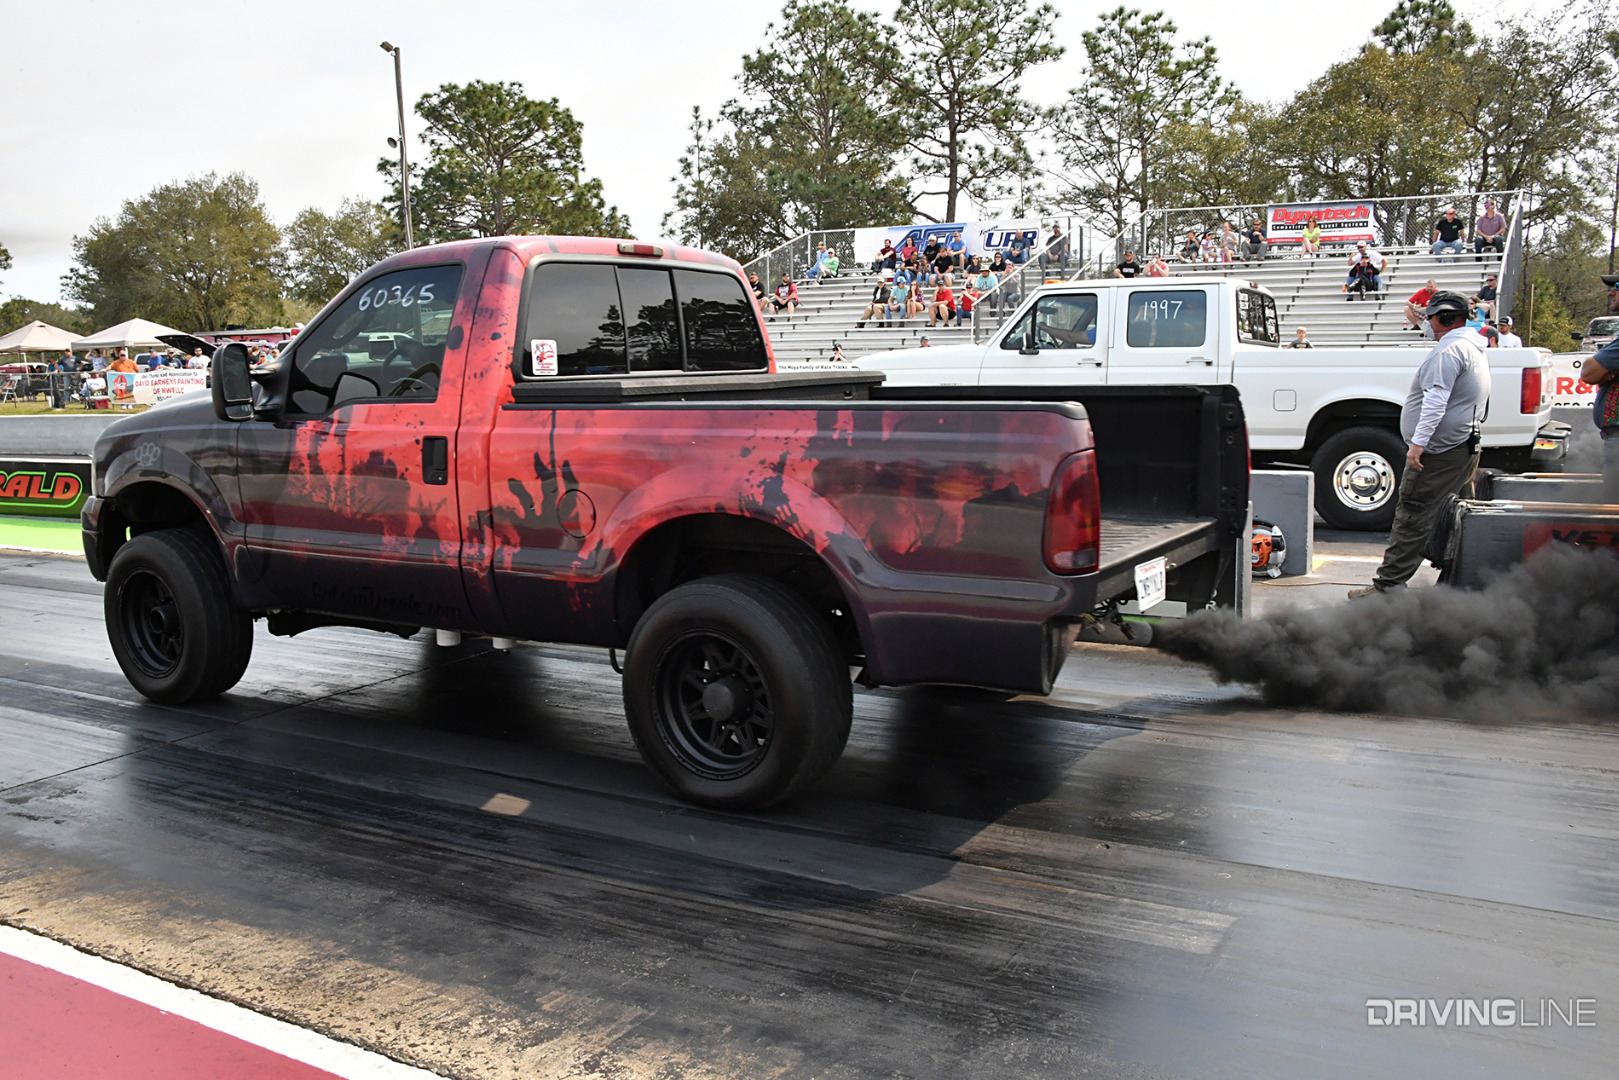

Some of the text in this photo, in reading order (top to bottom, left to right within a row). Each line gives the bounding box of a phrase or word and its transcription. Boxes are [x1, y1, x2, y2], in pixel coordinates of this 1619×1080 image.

[1272, 205, 1369, 224] Dynatech
[359, 283, 435, 311] 60365
[1143, 299, 1183, 321] 1997
[178, 378, 205, 386] PAINTING
